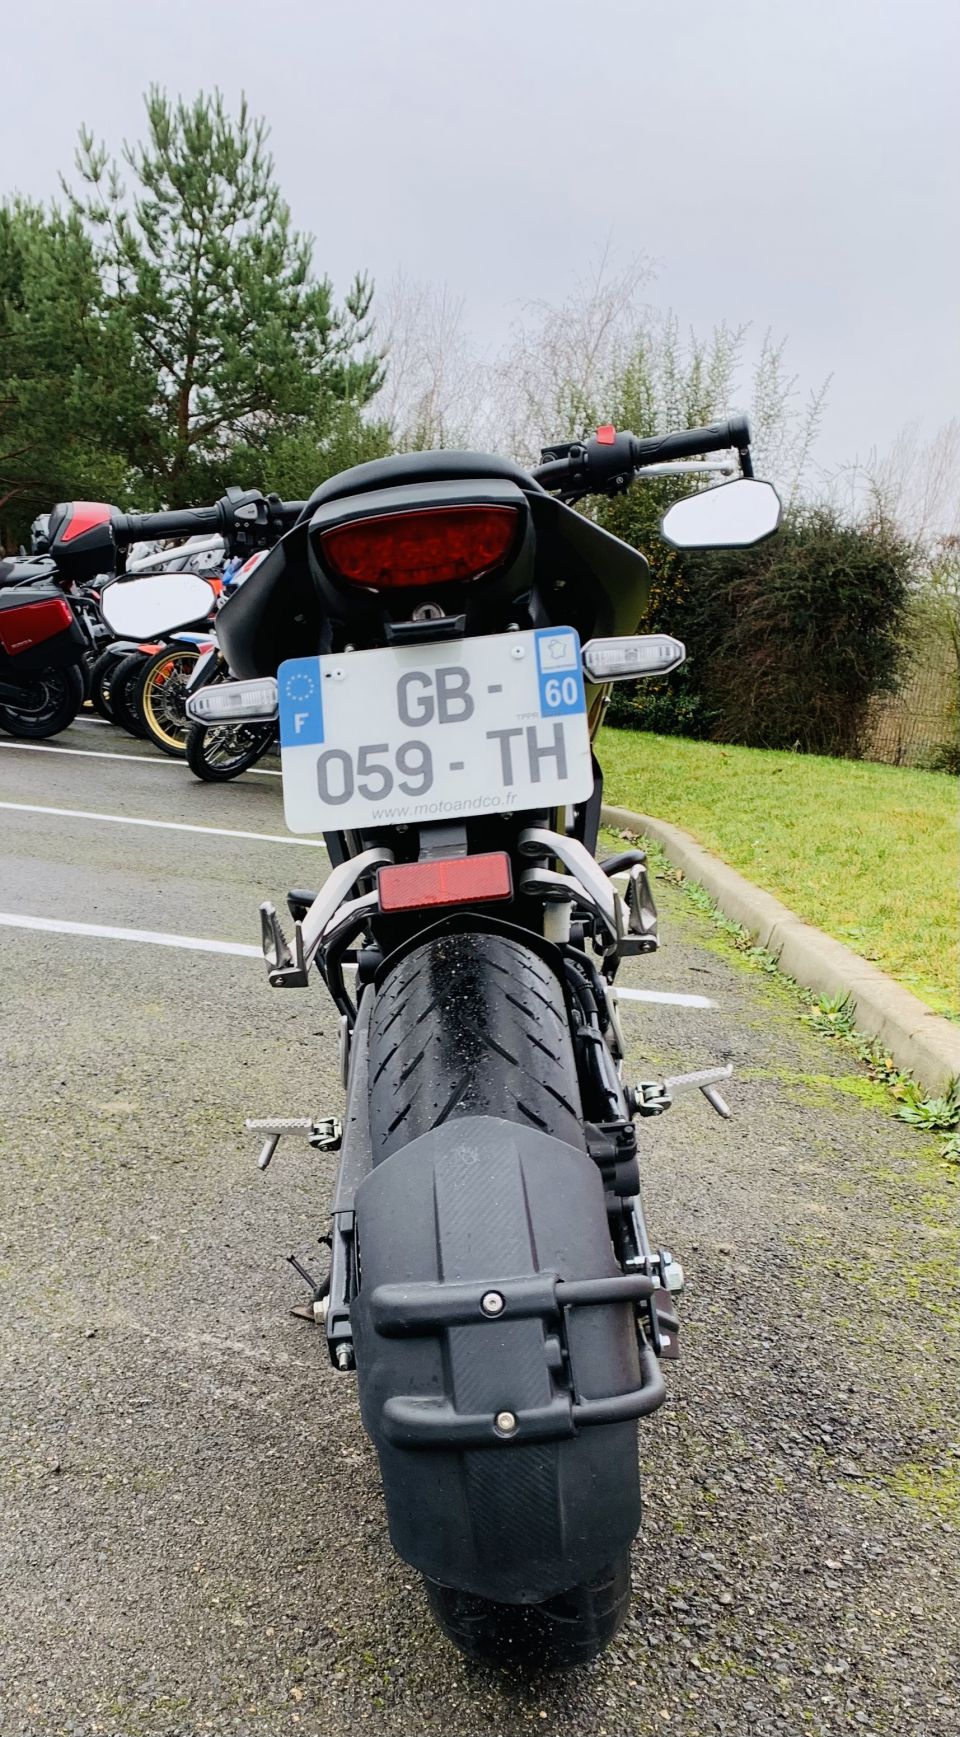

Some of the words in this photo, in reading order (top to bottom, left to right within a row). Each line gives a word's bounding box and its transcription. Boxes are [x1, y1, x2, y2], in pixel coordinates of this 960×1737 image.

[545, 677, 578, 707] 60
[294, 713, 309, 734] F
[372, 792, 518, 820] www.motoandco.fr
